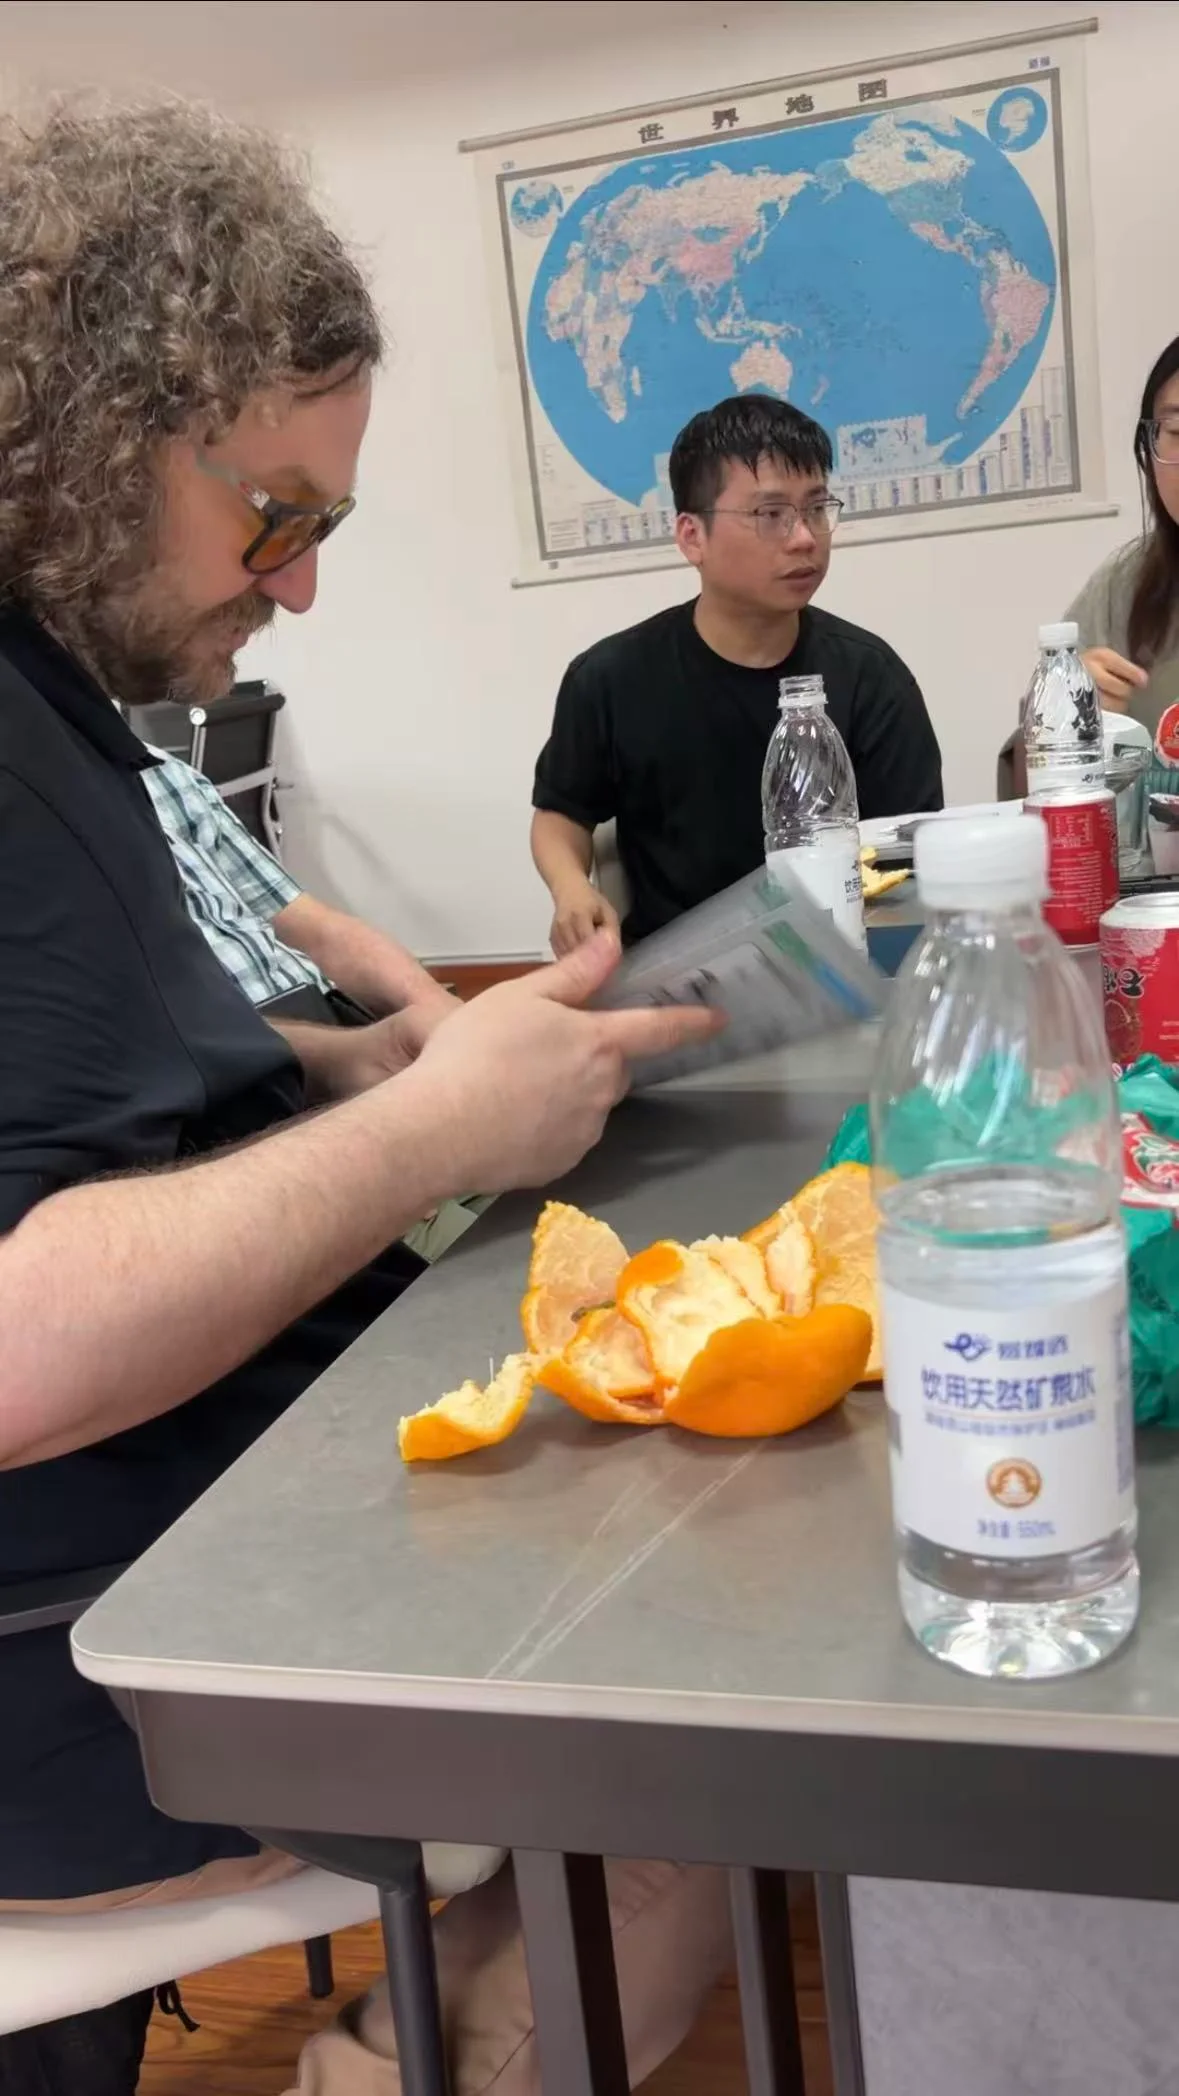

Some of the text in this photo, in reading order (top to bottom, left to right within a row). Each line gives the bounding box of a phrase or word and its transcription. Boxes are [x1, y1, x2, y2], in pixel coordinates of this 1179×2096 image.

[637, 78, 888, 144] 世界地图
[921, 1364, 1096, 1411] 饮用天然矿泉水
